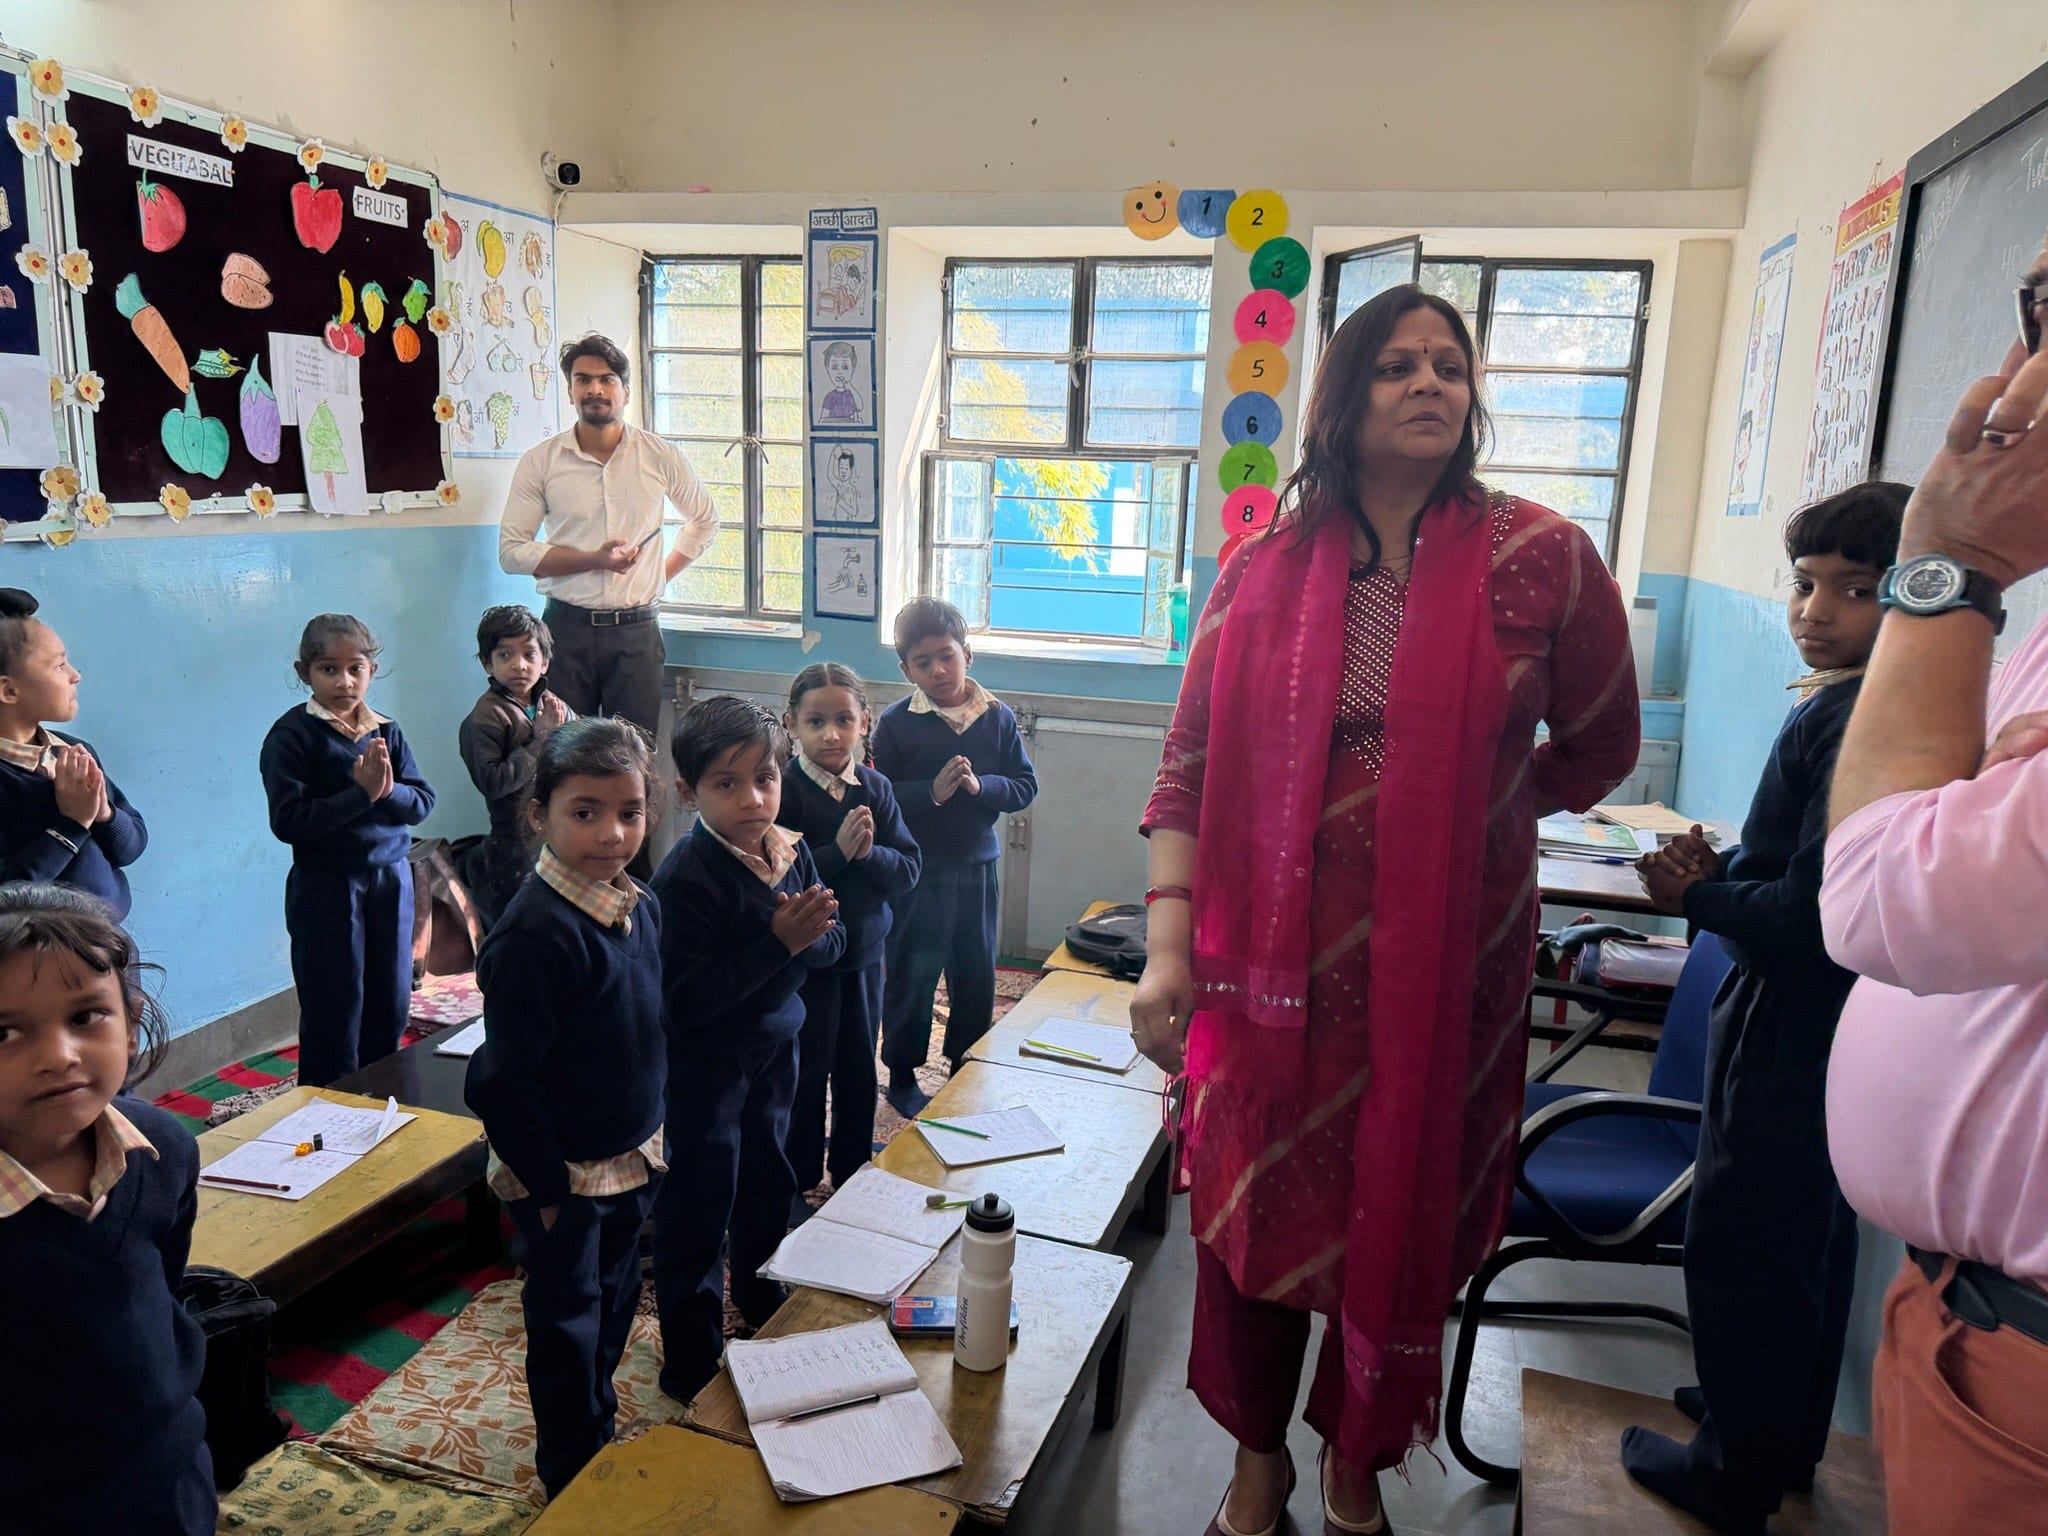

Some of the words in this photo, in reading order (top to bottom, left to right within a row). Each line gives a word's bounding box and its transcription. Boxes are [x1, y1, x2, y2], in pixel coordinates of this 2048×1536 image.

[131, 140, 231, 184] VEGITABAL
[355, 193, 401, 220] FRUITS
[1202, 196, 1212, 215] 1
[813, 211, 839, 226] अच्छी
[844, 211, 873, 226] आदतें
[1251, 207, 1264, 226] 2
[461, 220, 469, 233] अ
[504, 232, 514, 245] आ
[1271, 260, 1284, 279] 3
[1254, 310, 1267, 328] 4
[1252, 359, 1265, 378] 5
[1246, 415, 1258, 435] 6
[1243, 463, 1255, 481] 7
[1242, 505, 1254, 523] 8
